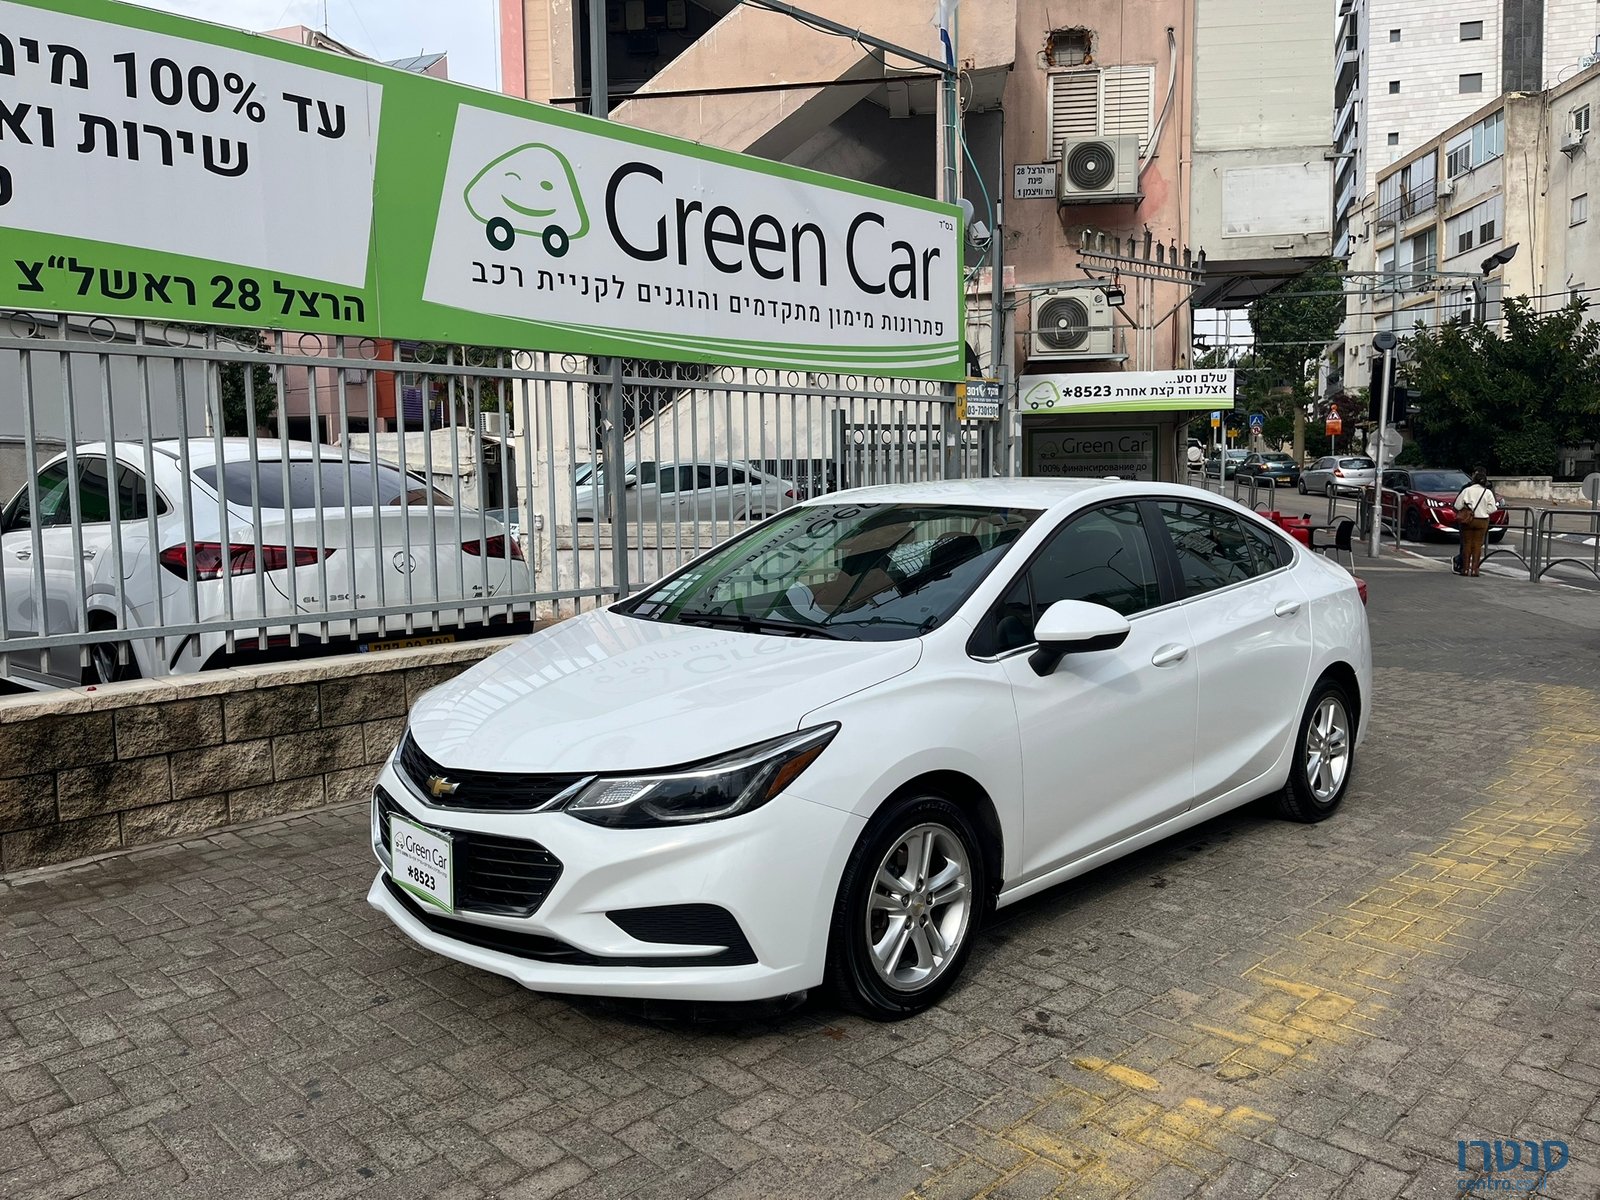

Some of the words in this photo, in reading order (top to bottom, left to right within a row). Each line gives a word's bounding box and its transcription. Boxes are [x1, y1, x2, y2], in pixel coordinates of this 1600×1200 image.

[113, 52, 266, 123] 100%
[282, 92, 346, 139] עד
[77, 113, 249, 177] שירות
[605, 162, 827, 287] Green
[846, 211, 940, 301] Car
[472, 260, 523, 287] רכב
[210, 274, 261, 312] 28
[272, 280, 365, 323] הרצל
[537, 273, 625, 303] לקניית
[638, 284, 718, 311] והוגנים
[730, 295, 820, 325] מתקדמים
[829, 308, 874, 330] מימון
[882, 314, 944, 337] פתרונות
[1178, 386, 1190, 395] זה
[1194, 384, 1227, 394] אצלנו
[1201, 372, 1227, 383] שלם
[1116, 388, 1146, 397] אחרת
[1150, 387, 1174, 397] קצת
[1062, 438, 1113, 454] Green
[1118, 436, 1148, 452] Car
[1038, 464, 1060, 473] 100%
[1062, 462, 1134, 474] финансирование
[1135, 463, 1147, 473] до
[405, 835, 431, 862] Green
[432, 848, 447, 870] Car
